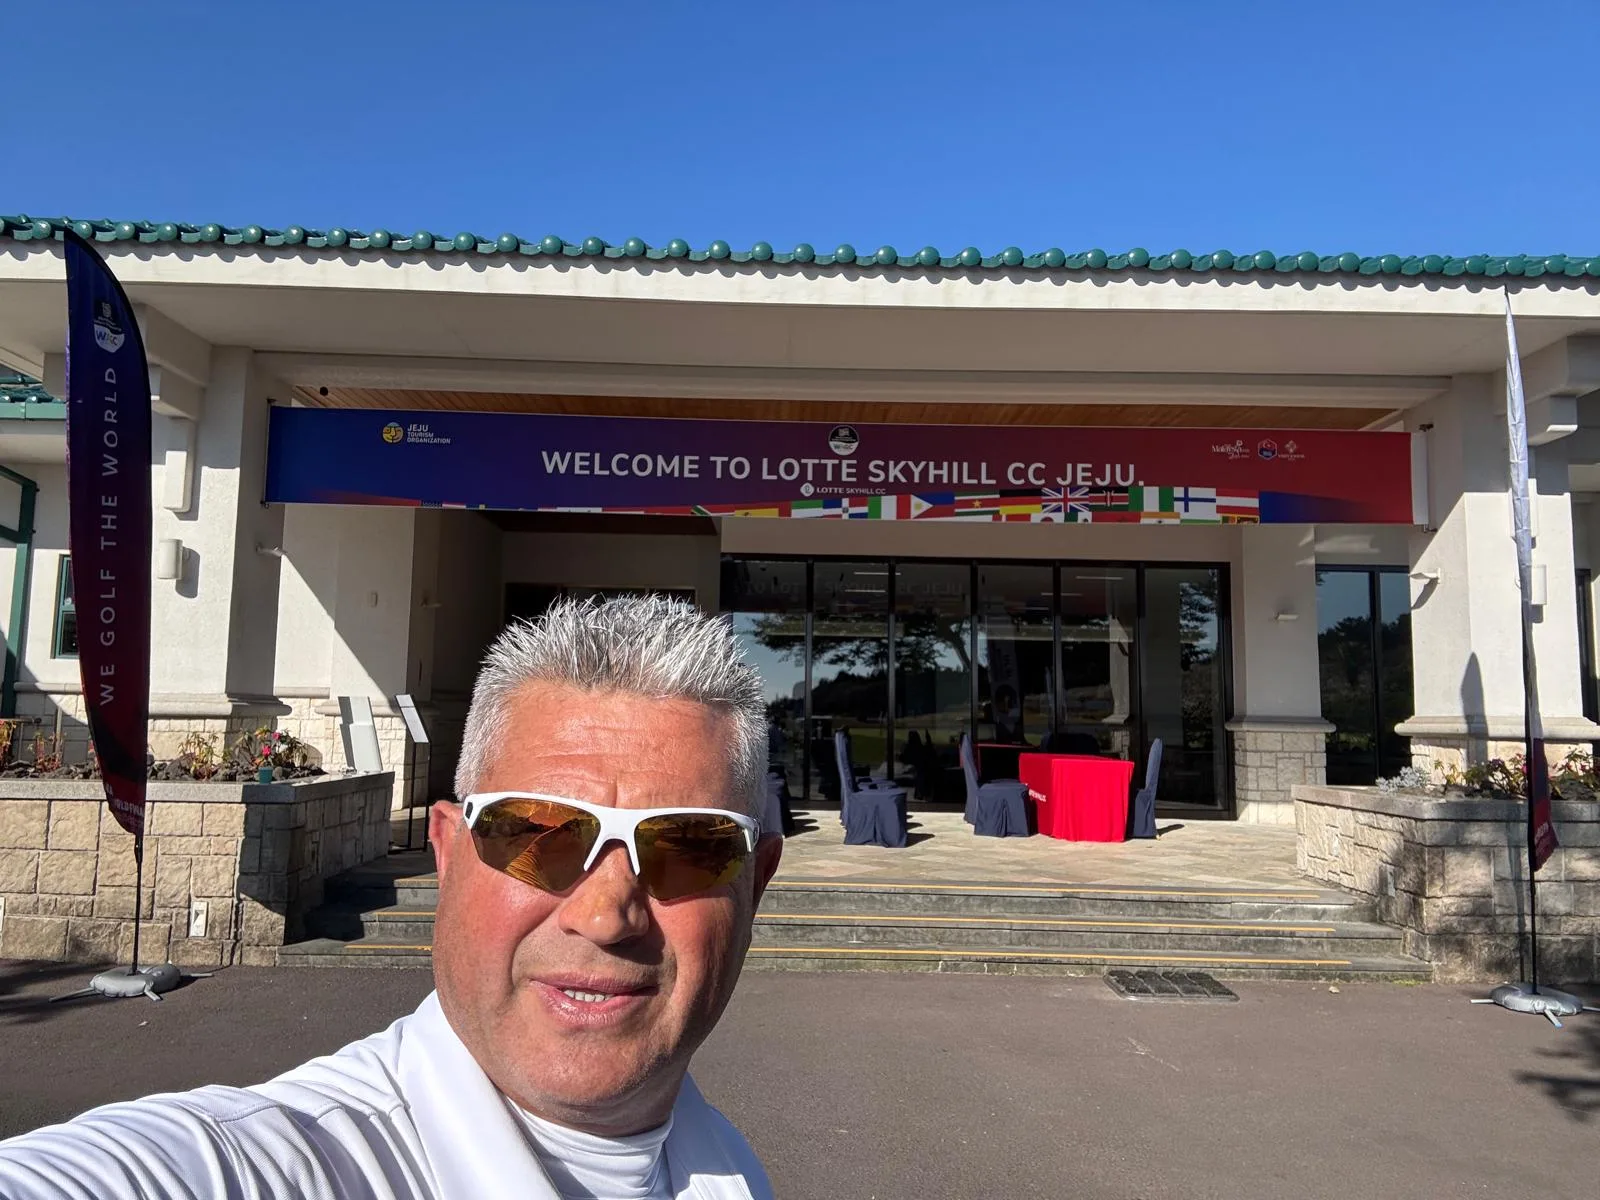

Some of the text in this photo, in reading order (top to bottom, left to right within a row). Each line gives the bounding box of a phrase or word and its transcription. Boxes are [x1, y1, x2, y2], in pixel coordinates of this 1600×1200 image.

[407, 424, 429, 432] JEJU
[541, 451, 1145, 489] WELCOME TO LOTTE SKYHILL CC JEJU.
[816, 486, 845, 494] LOTTE
[846, 487, 875, 495] SKYHILL
[100, 368, 118, 706] WE GOLF THE WORLD
